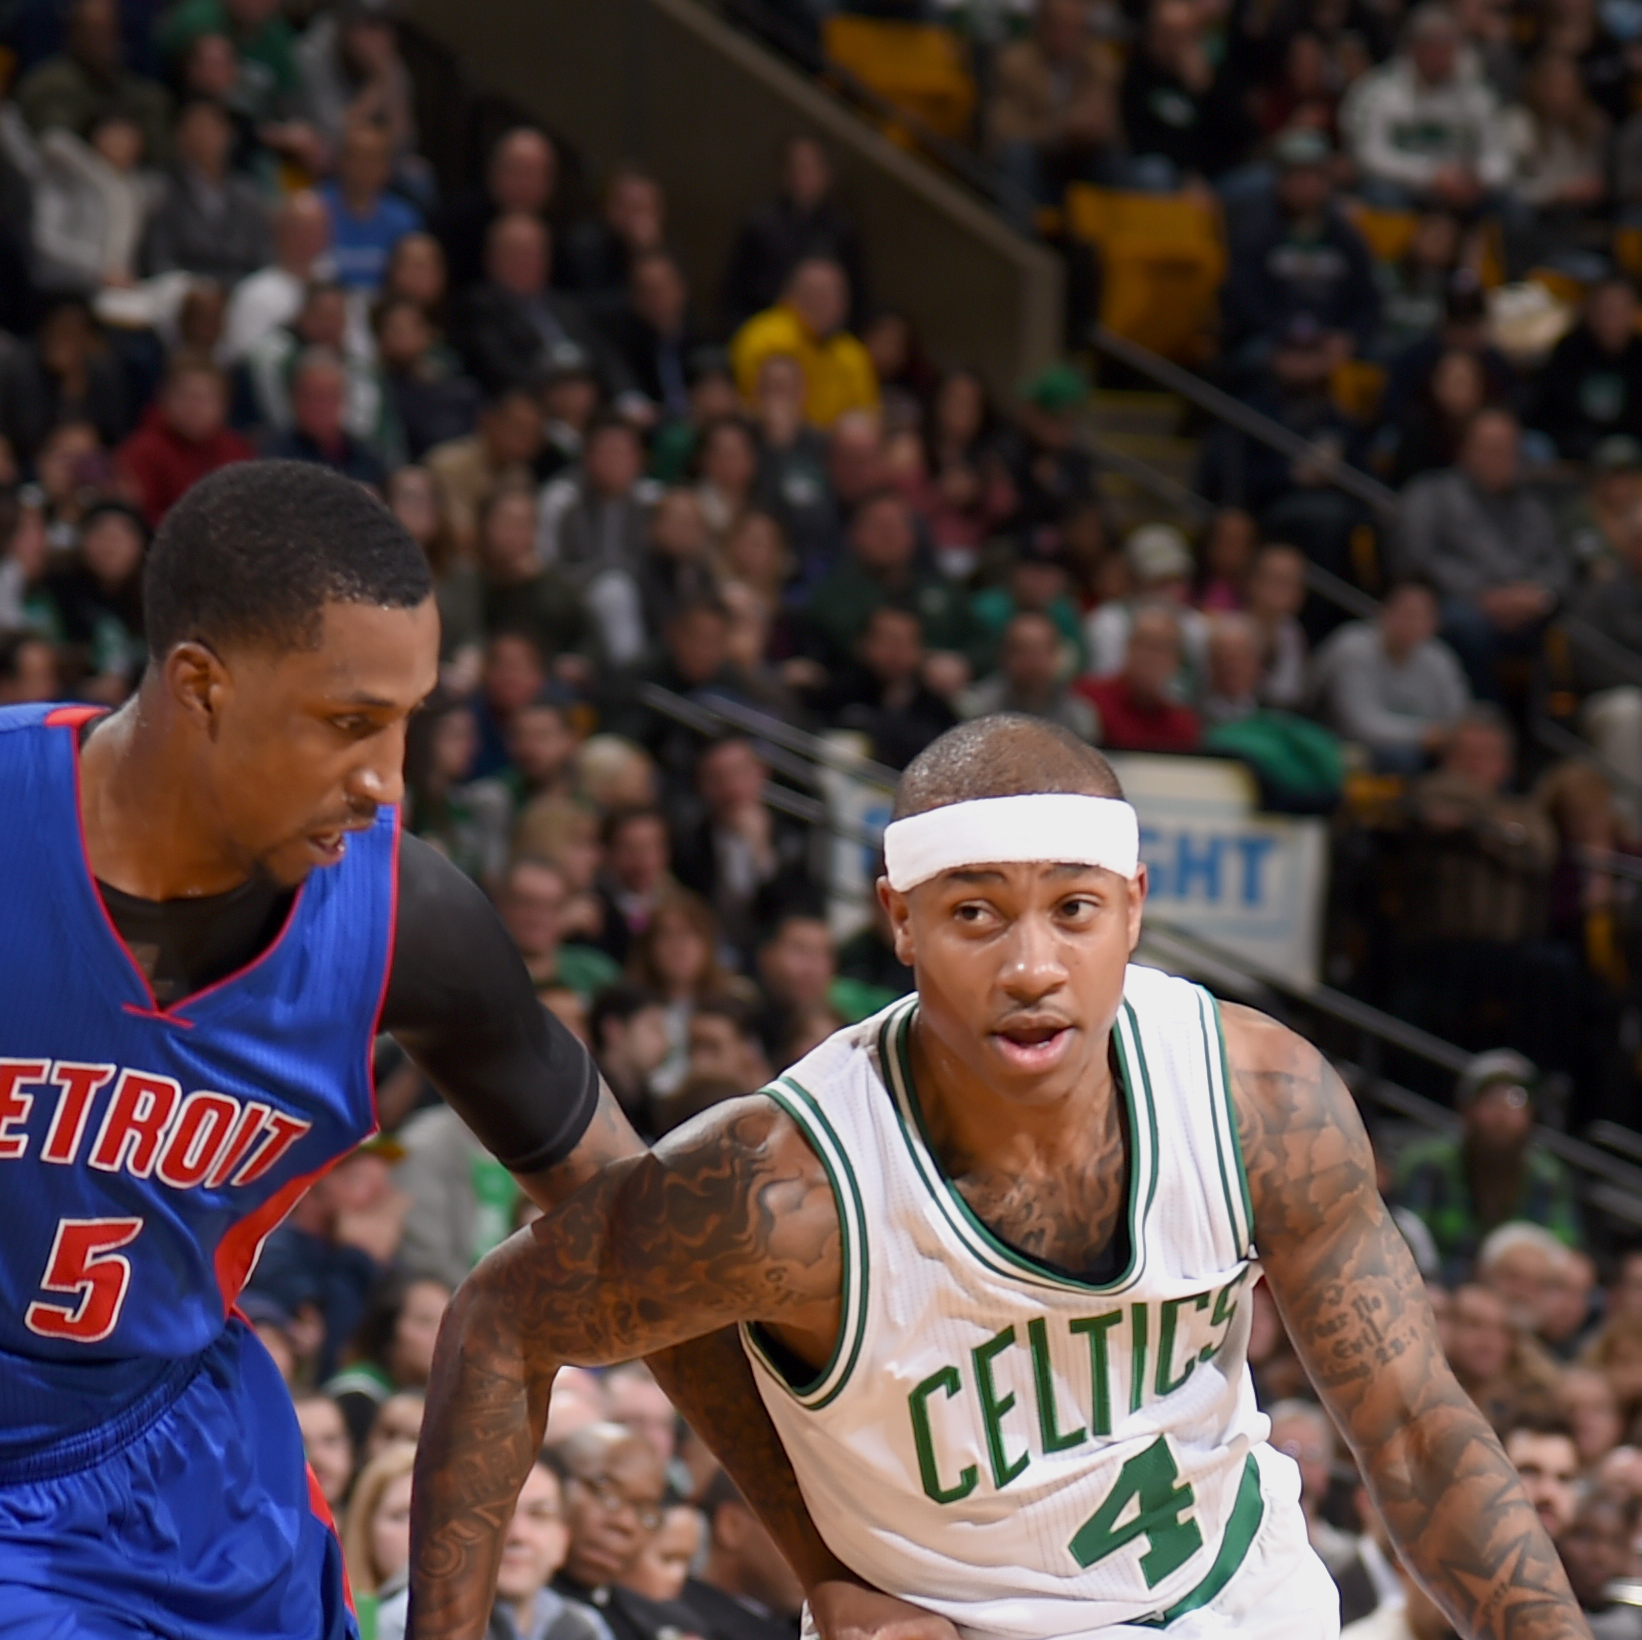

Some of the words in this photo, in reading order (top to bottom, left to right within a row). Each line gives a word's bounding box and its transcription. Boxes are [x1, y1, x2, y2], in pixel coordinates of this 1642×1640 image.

[1138, 828, 1277, 906] GHT
[24, 1216, 144, 1343] 5
[908, 1265, 1251, 1505] CELTICS
[1067, 1432, 1204, 1592] 4
